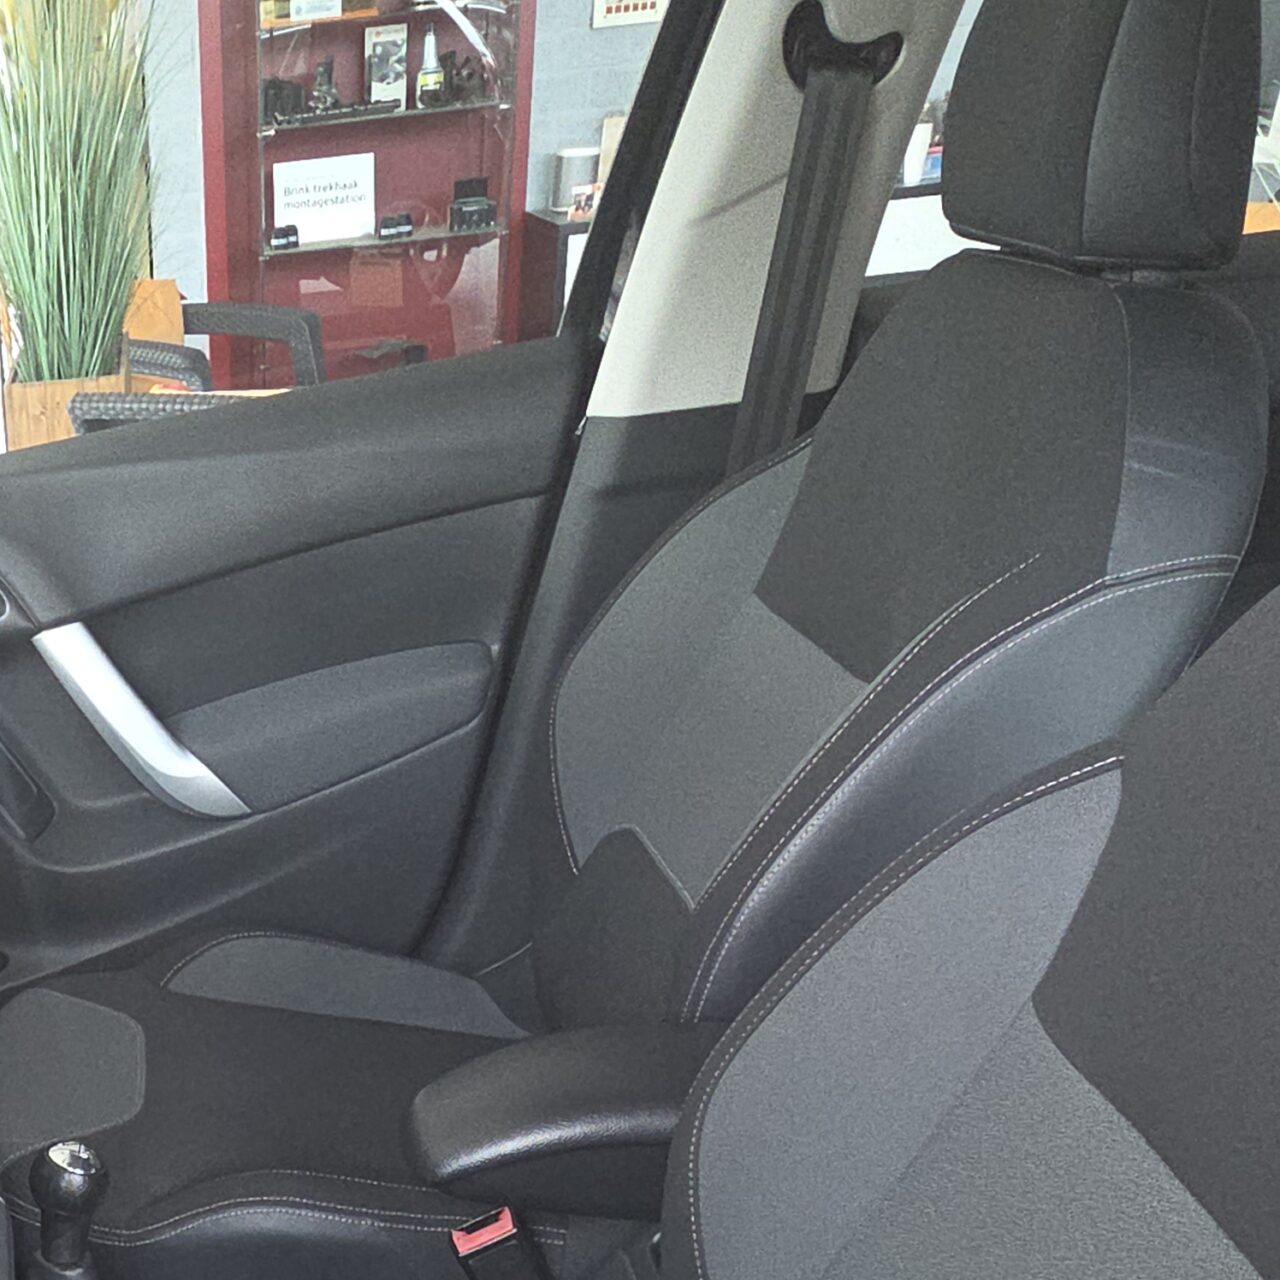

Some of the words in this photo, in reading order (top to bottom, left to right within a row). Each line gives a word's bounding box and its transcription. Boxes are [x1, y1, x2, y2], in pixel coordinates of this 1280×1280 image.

[283, 184, 309, 197] Brink
[312, 179, 358, 194] trekhaak
[283, 193, 366, 209] montagestation
